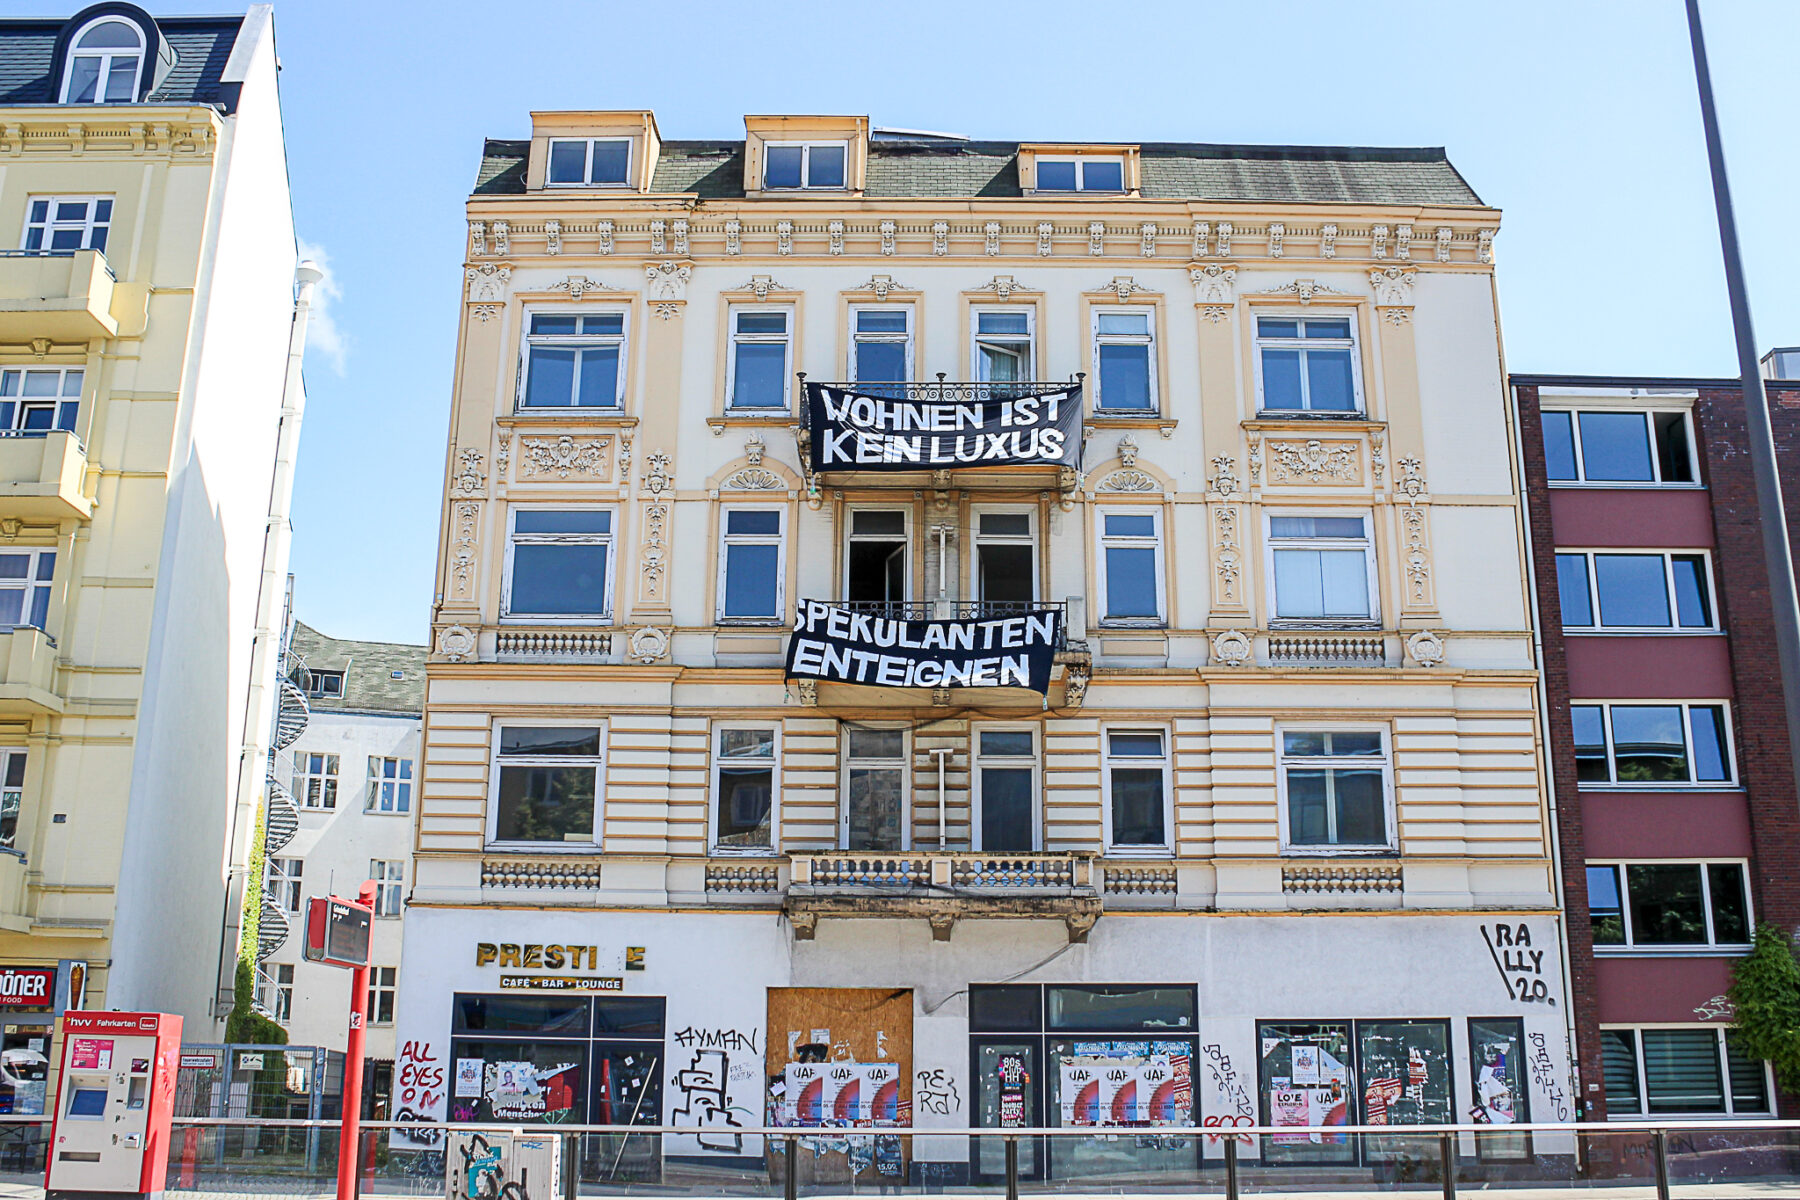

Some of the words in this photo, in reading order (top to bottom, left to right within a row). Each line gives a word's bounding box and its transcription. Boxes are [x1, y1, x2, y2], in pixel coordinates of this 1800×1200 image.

[820, 389, 983, 431] WOHNEN
[1000, 392, 1067, 427] IST
[929, 428, 1065, 463] LUXUS
[794, 599, 1054, 650] SPEKULANTEN
[502, 976, 530, 987] CAFÉ
[542, 980, 564, 988] BAR
[576, 980, 621, 989] LOUNGE
[70, 1017, 92, 1027] hvv
[97, 1019, 137, 1028] Fahrkarten
[400, 1040, 437, 1063] ALL
[674, 1026, 758, 1055] AYMAN
[1003, 1057, 1021, 1067] 80s
[400, 1063, 443, 1088] EYES
[1005, 1073, 1019, 1083] HH
[401, 1088, 440, 1110] ON
[1316, 1092, 1335, 1104] JA
